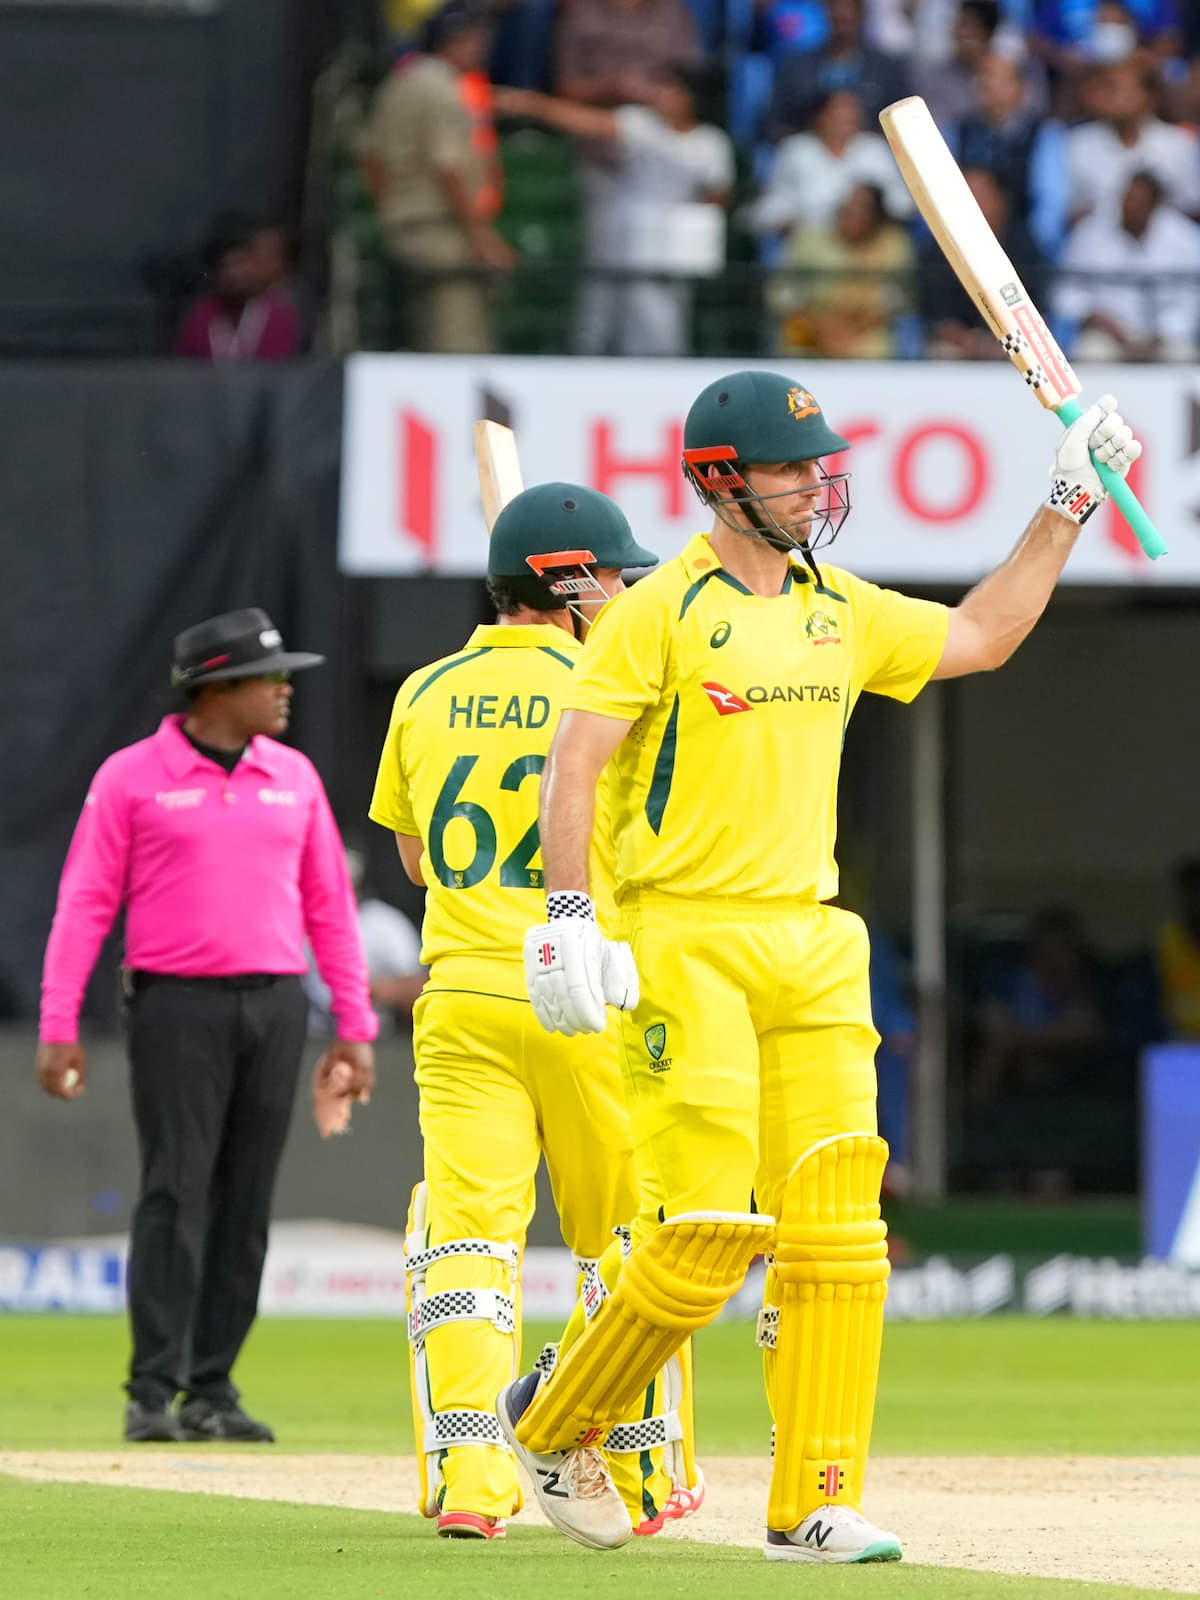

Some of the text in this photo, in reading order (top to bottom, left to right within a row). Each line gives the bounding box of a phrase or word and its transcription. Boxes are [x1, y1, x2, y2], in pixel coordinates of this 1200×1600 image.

[589, 418, 991, 526] Hro
[449, 695, 550, 729] HEAD
[746, 685, 841, 704] QANTAS
[428, 754, 546, 889] 62
